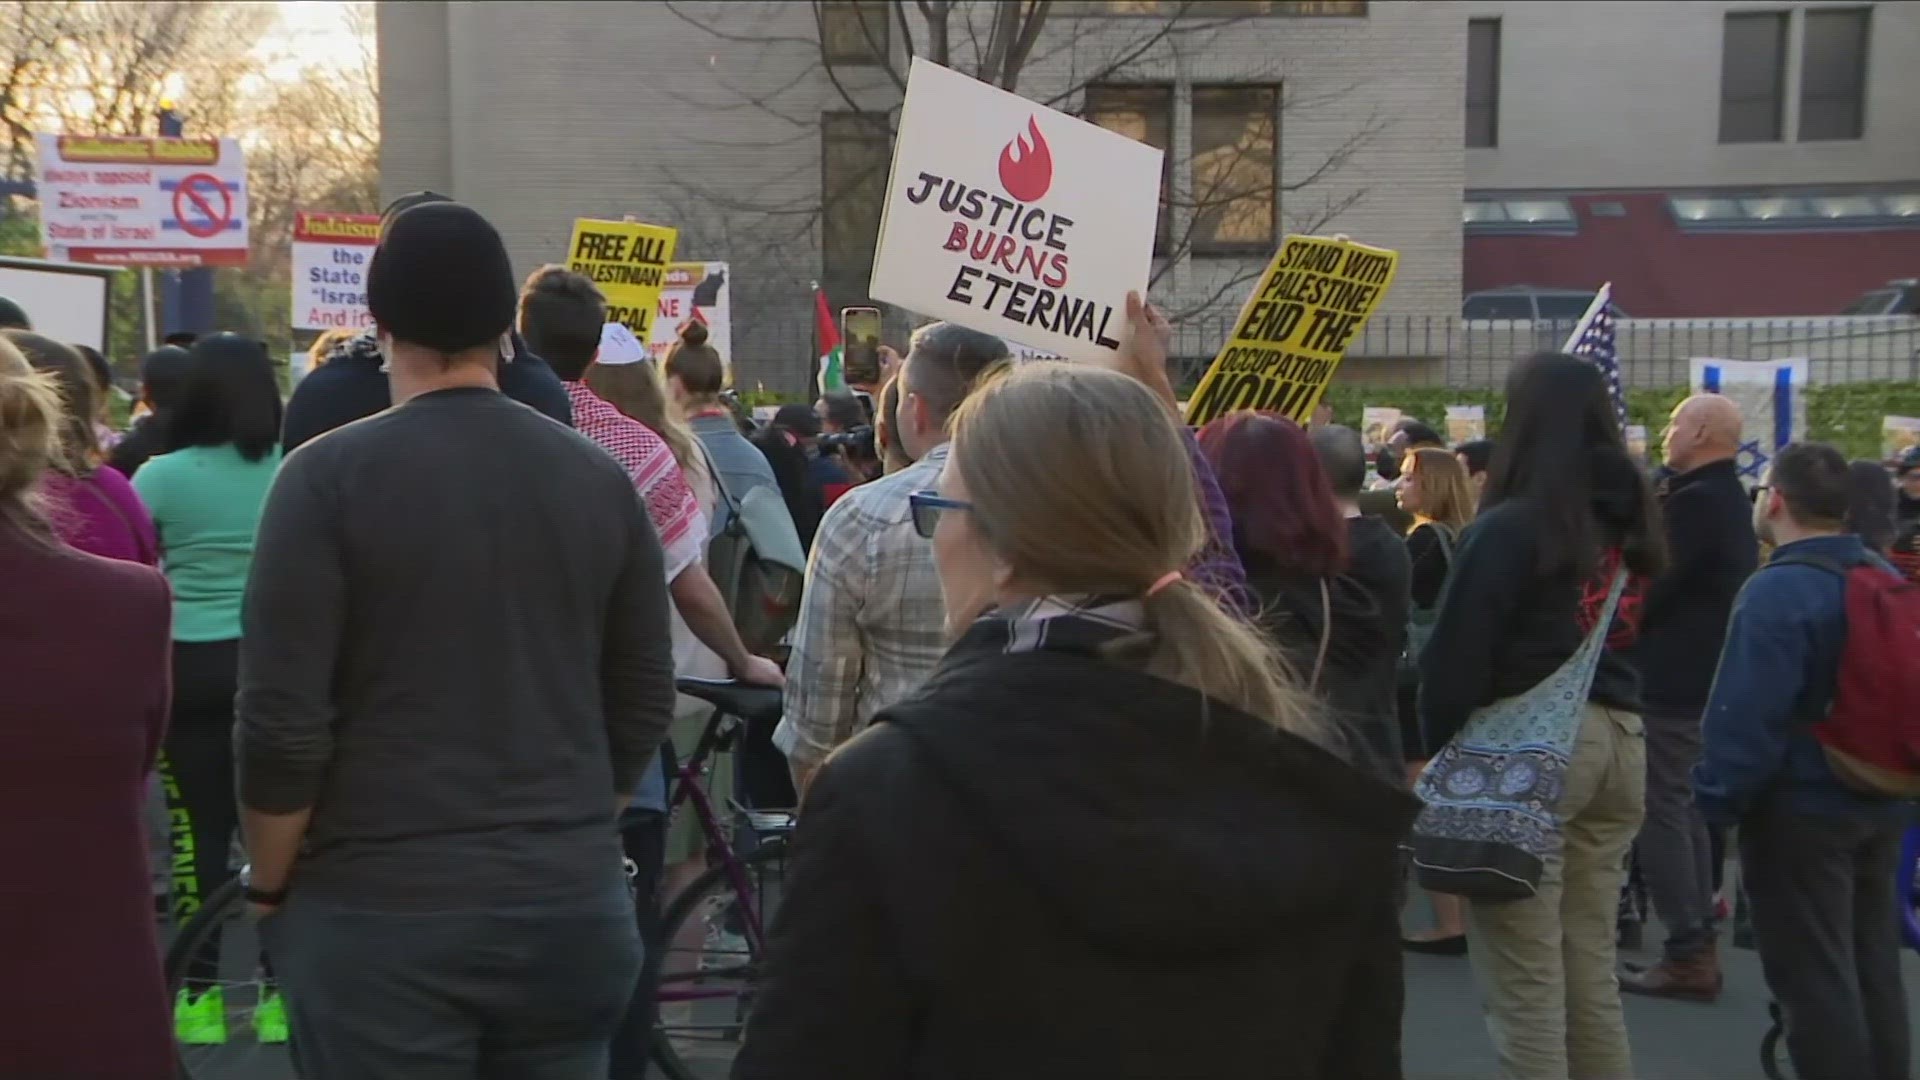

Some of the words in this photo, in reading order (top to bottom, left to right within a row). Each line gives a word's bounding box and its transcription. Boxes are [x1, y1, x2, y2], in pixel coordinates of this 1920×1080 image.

[58, 191, 141, 209] Zionism
[907, 171, 1074, 251] JUSTICE
[49, 223, 86, 240] State
[91, 225, 106, 240] of
[575, 232, 628, 262] FREE
[628, 236, 666, 265] ALL
[332, 247, 364, 265] the
[943, 221, 1068, 289] BURNS
[1279, 241, 1344, 274] STAND
[1341, 249, 1393, 284] WITH
[309, 266, 361, 285] State
[1261, 271, 1380, 314] PALESTINE!
[308, 307, 347, 327] And
[946, 265, 1121, 351] ETERNAL
[1237, 301, 1305, 342] END
[1300, 308, 1364, 353] THE
[1219, 346, 1334, 384] OCCUPATION
[1187, 373, 1319, 426] NOW!
